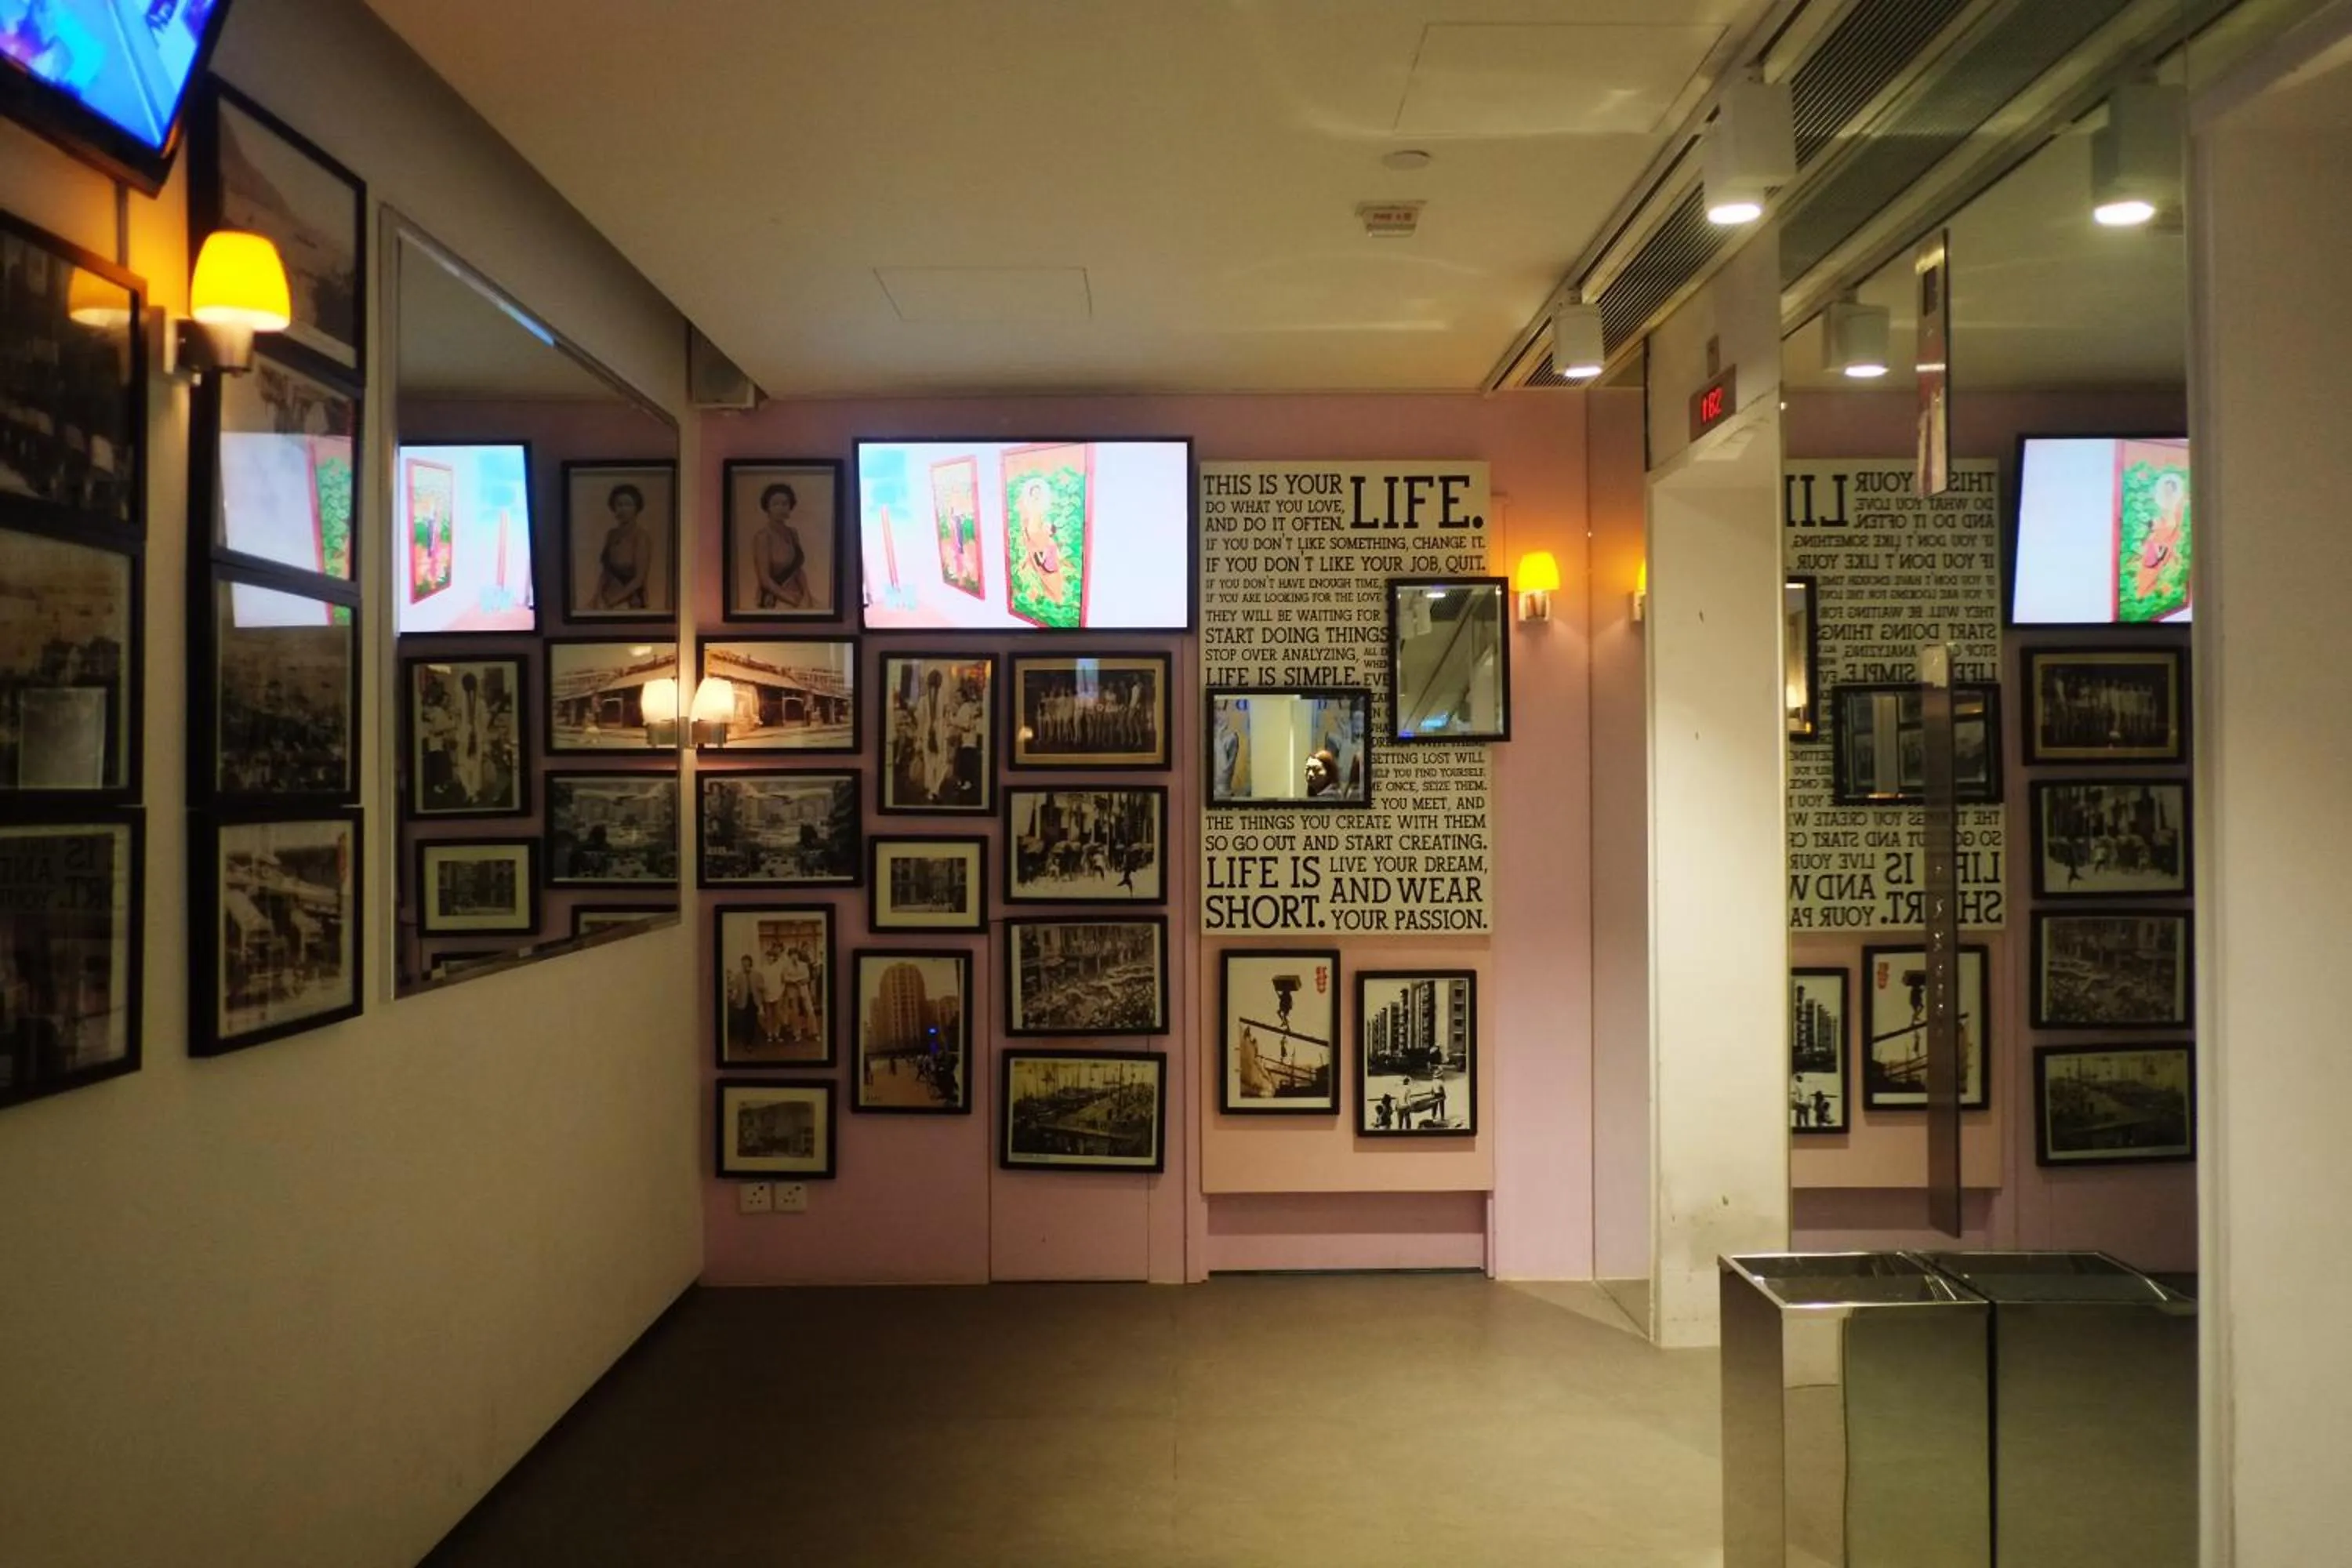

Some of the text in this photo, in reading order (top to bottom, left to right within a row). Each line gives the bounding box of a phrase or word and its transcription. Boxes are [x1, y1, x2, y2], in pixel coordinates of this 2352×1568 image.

[1204, 474, 1342, 495] THIS IS YOUR
[1205, 501, 1225, 513] DO
[1231, 501, 1271, 513] WHAT
[1276, 501, 1302, 513] YOU
[1350, 476, 1483, 528] LIFE.
[1205, 517, 1344, 532] AND DO IT OFTEN.
[1206, 539, 1217, 550] IF
[1224, 539, 1248, 550] YOU
[1298, 539, 1325, 550] LIKE
[1330, 537, 1409, 550] SOMETHING,
[1413, 537, 1467, 549] CHANGE
[1206, 557, 1219, 572] IF
[1225, 557, 1256, 572] YOU
[1320, 557, 1355, 572] LIKE
[1361, 557, 1403, 571] YOUR
[1410, 556, 1441, 573] JOB,
[1446, 556, 1486, 572] QUIT.
[1206, 579, 1215, 589] IF
[1219, 579, 1239, 589] YOU
[1279, 579, 1305, 589] HAVE
[1309, 579, 1352, 589] ENOUGH
[1206, 593, 1382, 602] IF YOU ARE LOOKING FOR THE LOVE
[1206, 610, 1381, 622] THEY WILL BE WAITING FOR
[1205, 628, 1389, 644] START DOING THINGS
[1205, 648, 1359, 663] STOP OVER ANALYZING,
[1206, 667, 1361, 685] LIFE IS SIMPLE.
[1364, 672, 1388, 686] EVE
[1423, 752, 1450, 764] LOST
[1455, 751, 1485, 764] WILL
[1393, 768, 1412, 778] YOU
[1415, 768, 1436, 778] FIND
[1385, 781, 1419, 793] ONCE,
[1423, 780, 1450, 791] SEIZE
[1455, 780, 1487, 791] THEM.
[1381, 797, 1407, 810] YOU
[1412, 796, 1450, 811] MEET,
[1456, 796, 1486, 810] AND
[1206, 815, 1486, 830] THE THINGS YOU CREATE WITH THEM
[1205, 834, 1488, 851] SO GO OUT AND START CREATING.
[1207, 856, 1320, 888] LIFE IS
[1330, 856, 1488, 874] LIVE YOUR DREAM,
[1330, 877, 1483, 903] AND WEAR
[1205, 895, 1326, 929] SHORT.
[1331, 909, 1488, 930] YOUR PASSION.
